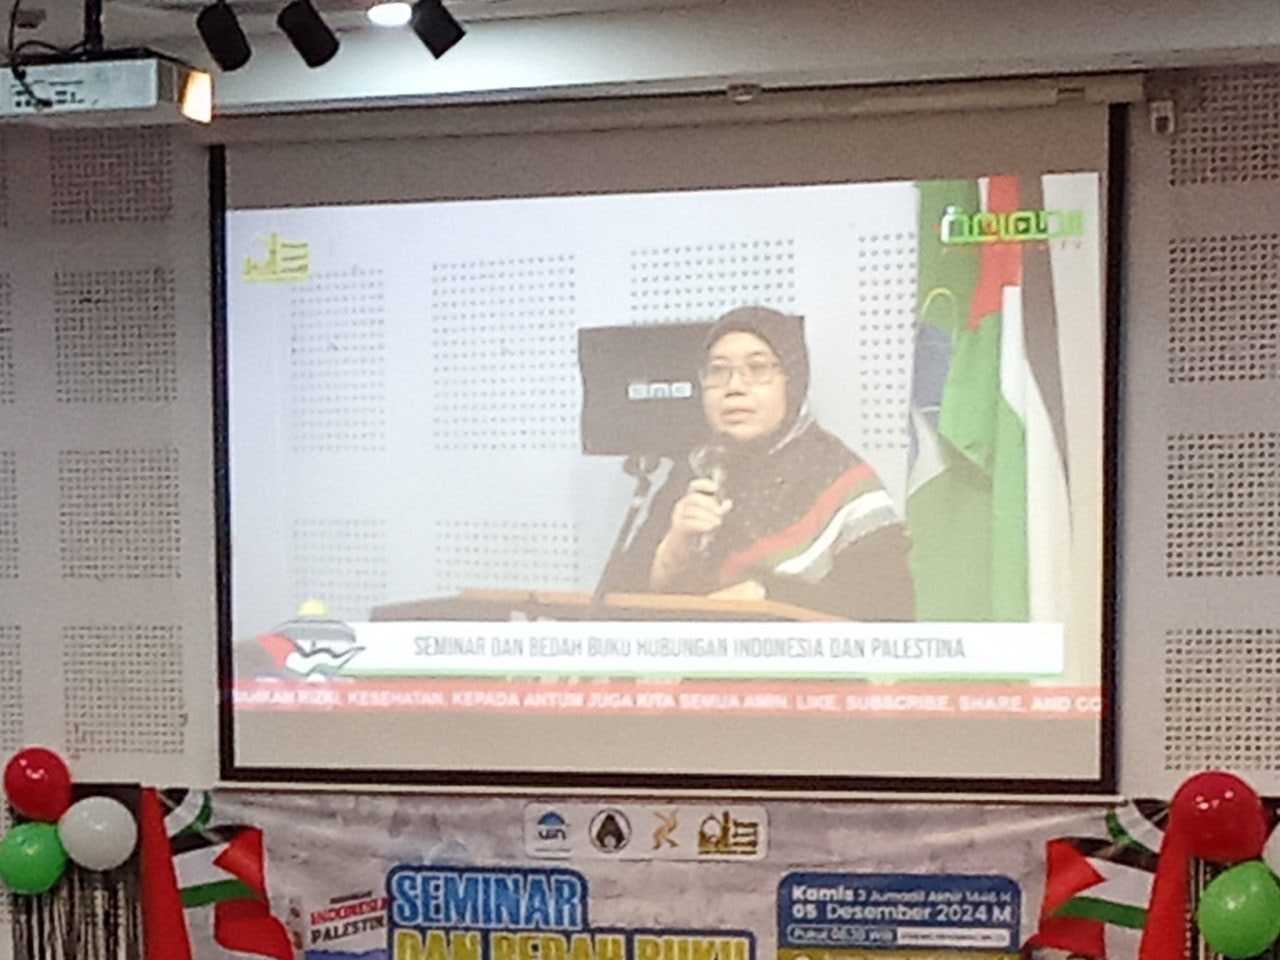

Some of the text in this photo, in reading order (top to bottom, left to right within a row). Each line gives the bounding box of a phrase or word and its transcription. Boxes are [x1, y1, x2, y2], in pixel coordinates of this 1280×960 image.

[414, 636, 966, 659] SEMINAR DAN BEDAH BUKU HUBUNGAN INDONESIA DAN PALESTINA
[452, 691, 519, 707] KEPADA
[523, 692, 584, 707] ANTUM
[587, 692, 634, 708] JUGA
[636, 692, 676, 708] KITA
[679, 693, 740, 709] SEMUA
[1031, 696, 1071, 711] AND
[391, 871, 583, 929] SEMINAR
[792, 884, 854, 902] Kamis
[311, 897, 388, 926] INDONESI
[792, 904, 1011, 922] 05 Desember 2024 M
[311, 915, 385, 944] PALESTIN
